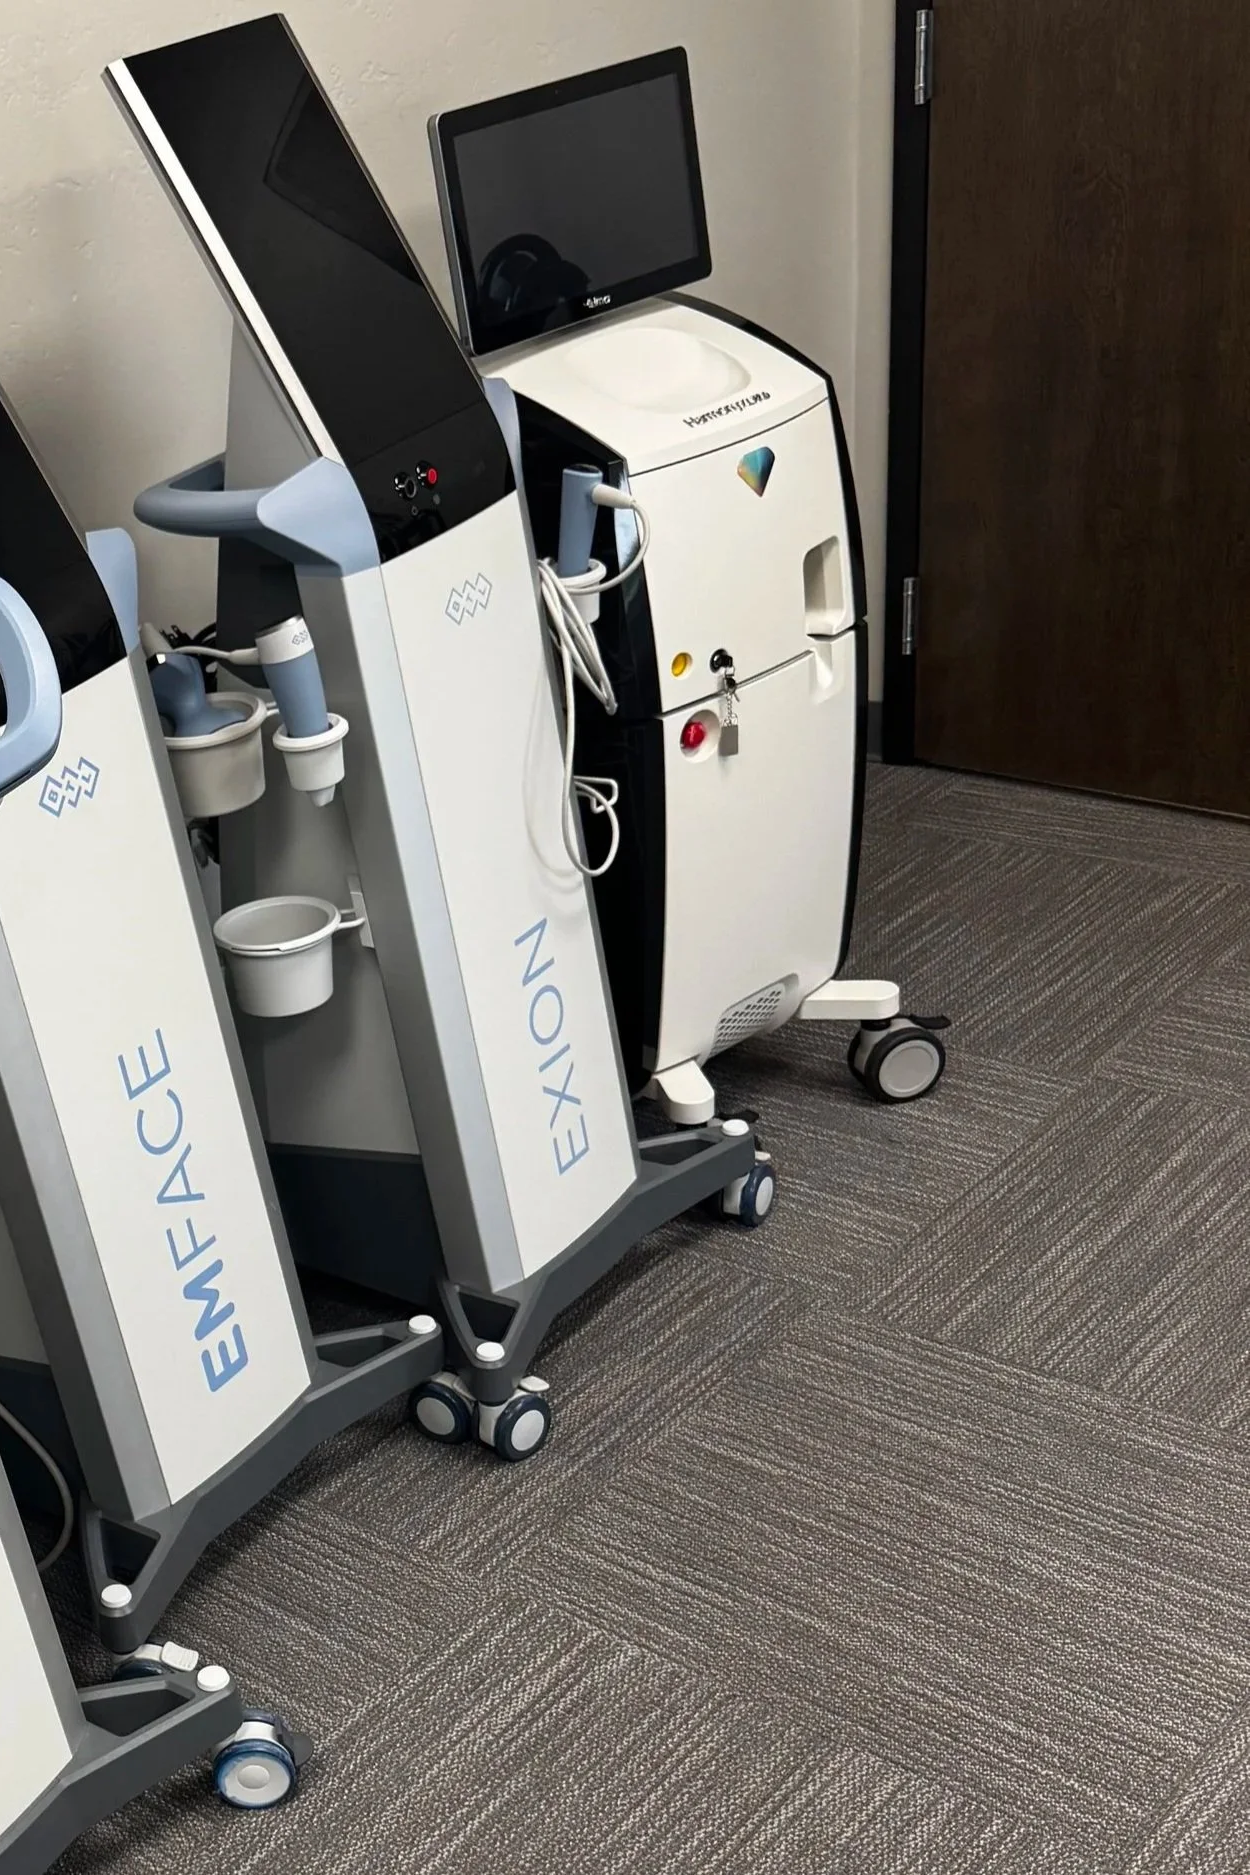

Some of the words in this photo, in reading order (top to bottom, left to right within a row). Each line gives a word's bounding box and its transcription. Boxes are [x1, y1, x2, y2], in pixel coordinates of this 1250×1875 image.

[45, 768, 95, 808] BTL
[513, 917, 591, 1177] EXION
[117, 1028, 249, 1393] EMFACE
